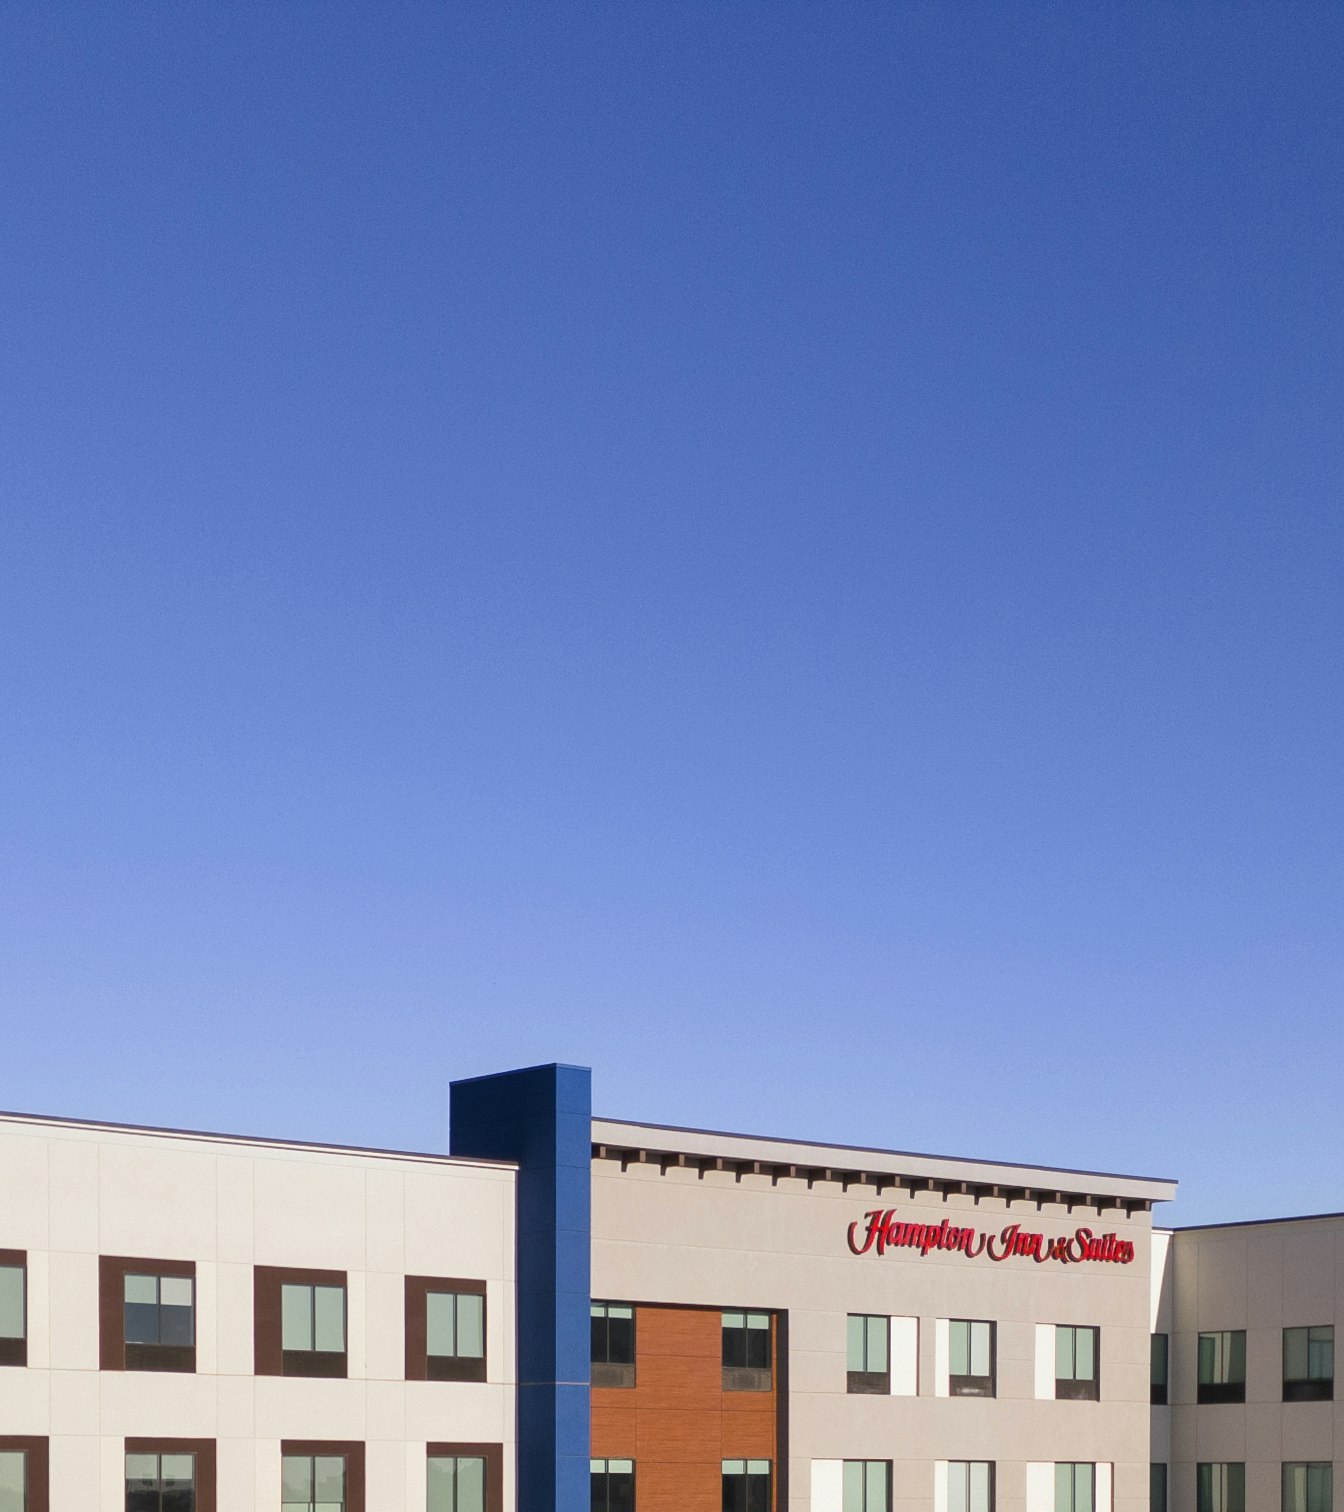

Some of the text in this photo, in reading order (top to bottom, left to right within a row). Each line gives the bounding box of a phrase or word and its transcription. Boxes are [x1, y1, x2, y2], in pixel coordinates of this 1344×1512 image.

[847, 1208, 987, 1258] Hampton
[986, 1223, 1055, 1263] Inn
[1065, 1227, 1135, 1264] Suites
